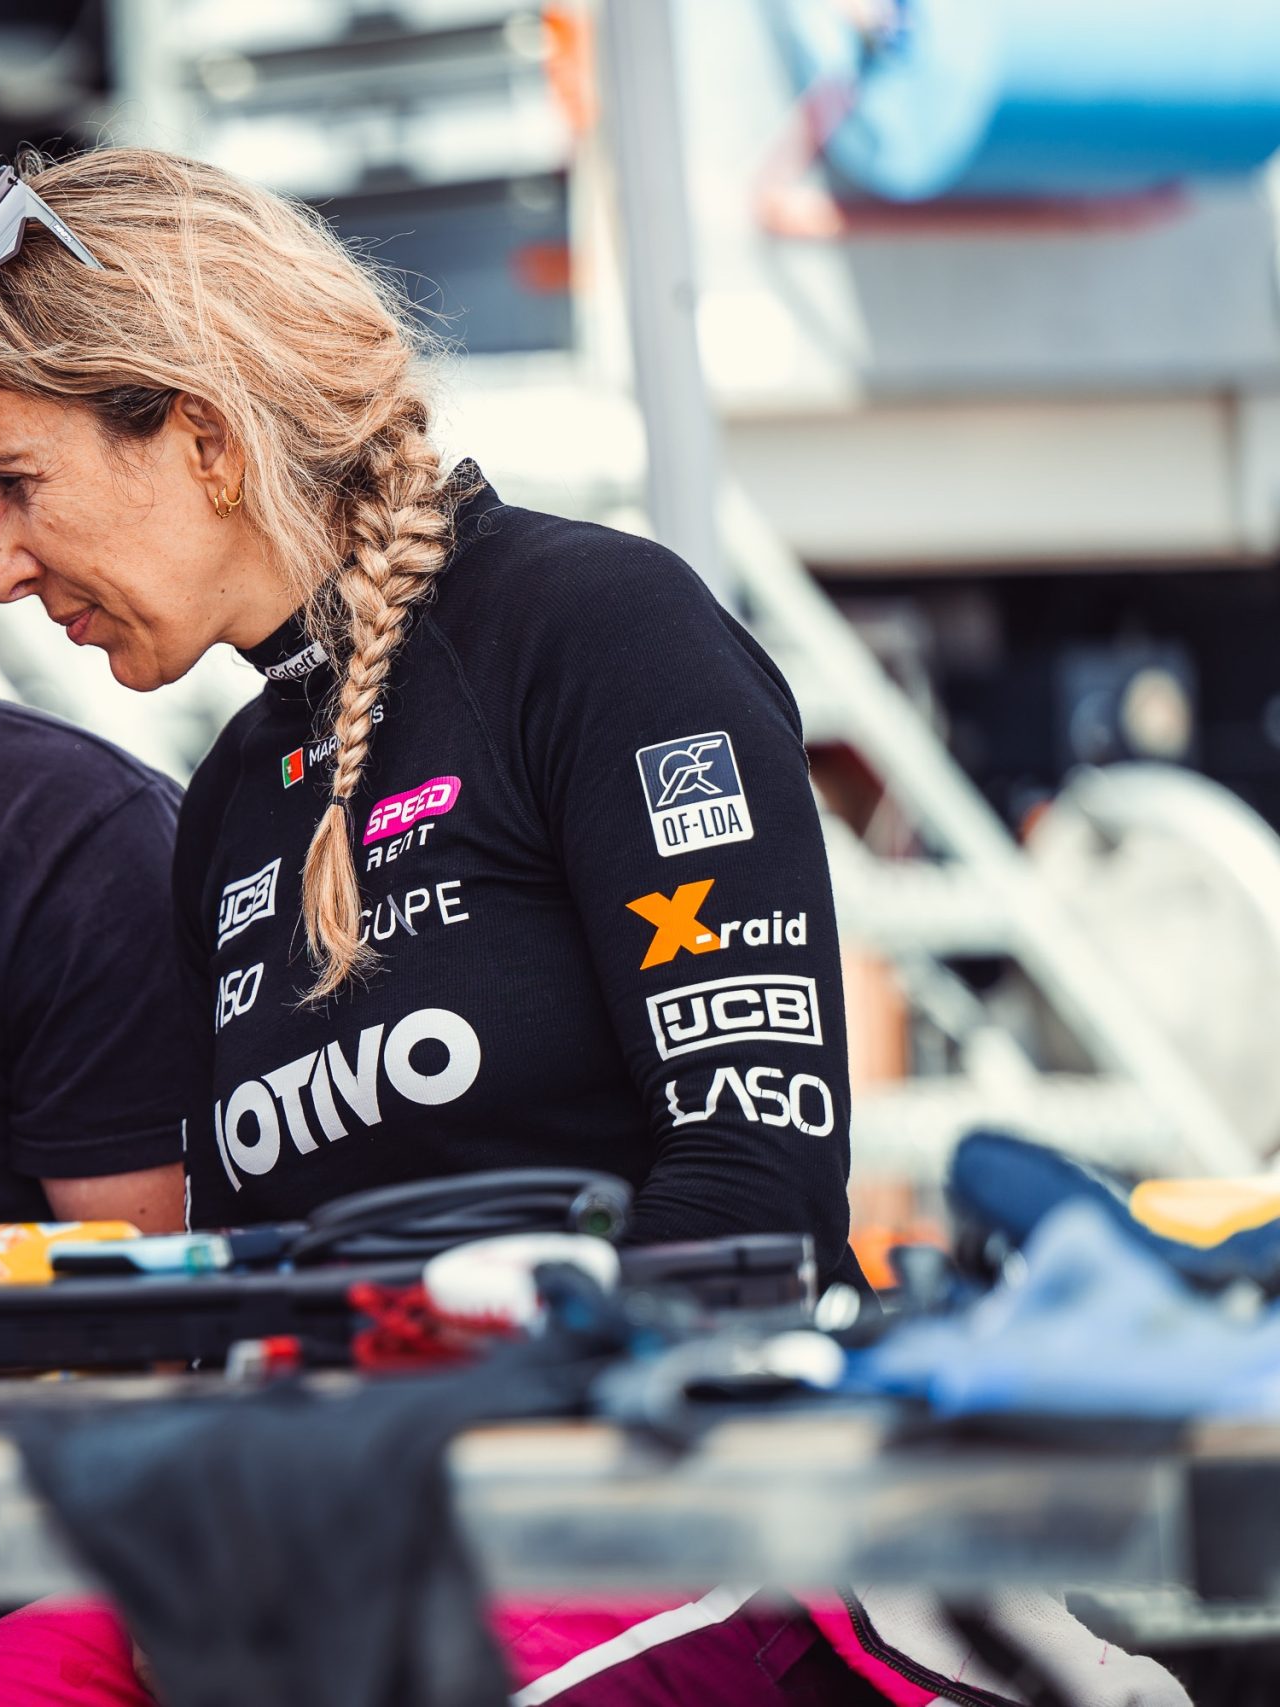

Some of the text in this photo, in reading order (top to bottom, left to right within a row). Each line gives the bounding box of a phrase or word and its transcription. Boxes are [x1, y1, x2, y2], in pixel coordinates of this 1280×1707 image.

[366, 783, 452, 836] SPEED
[662, 803, 743, 847] QF-LDA
[366, 823, 435, 872] RENT
[624, 878, 807, 970] X-raid
[662, 988, 810, 1041] JCB
[215, 1008, 481, 1192] OTIVO
[665, 1066, 835, 1138] LASO
